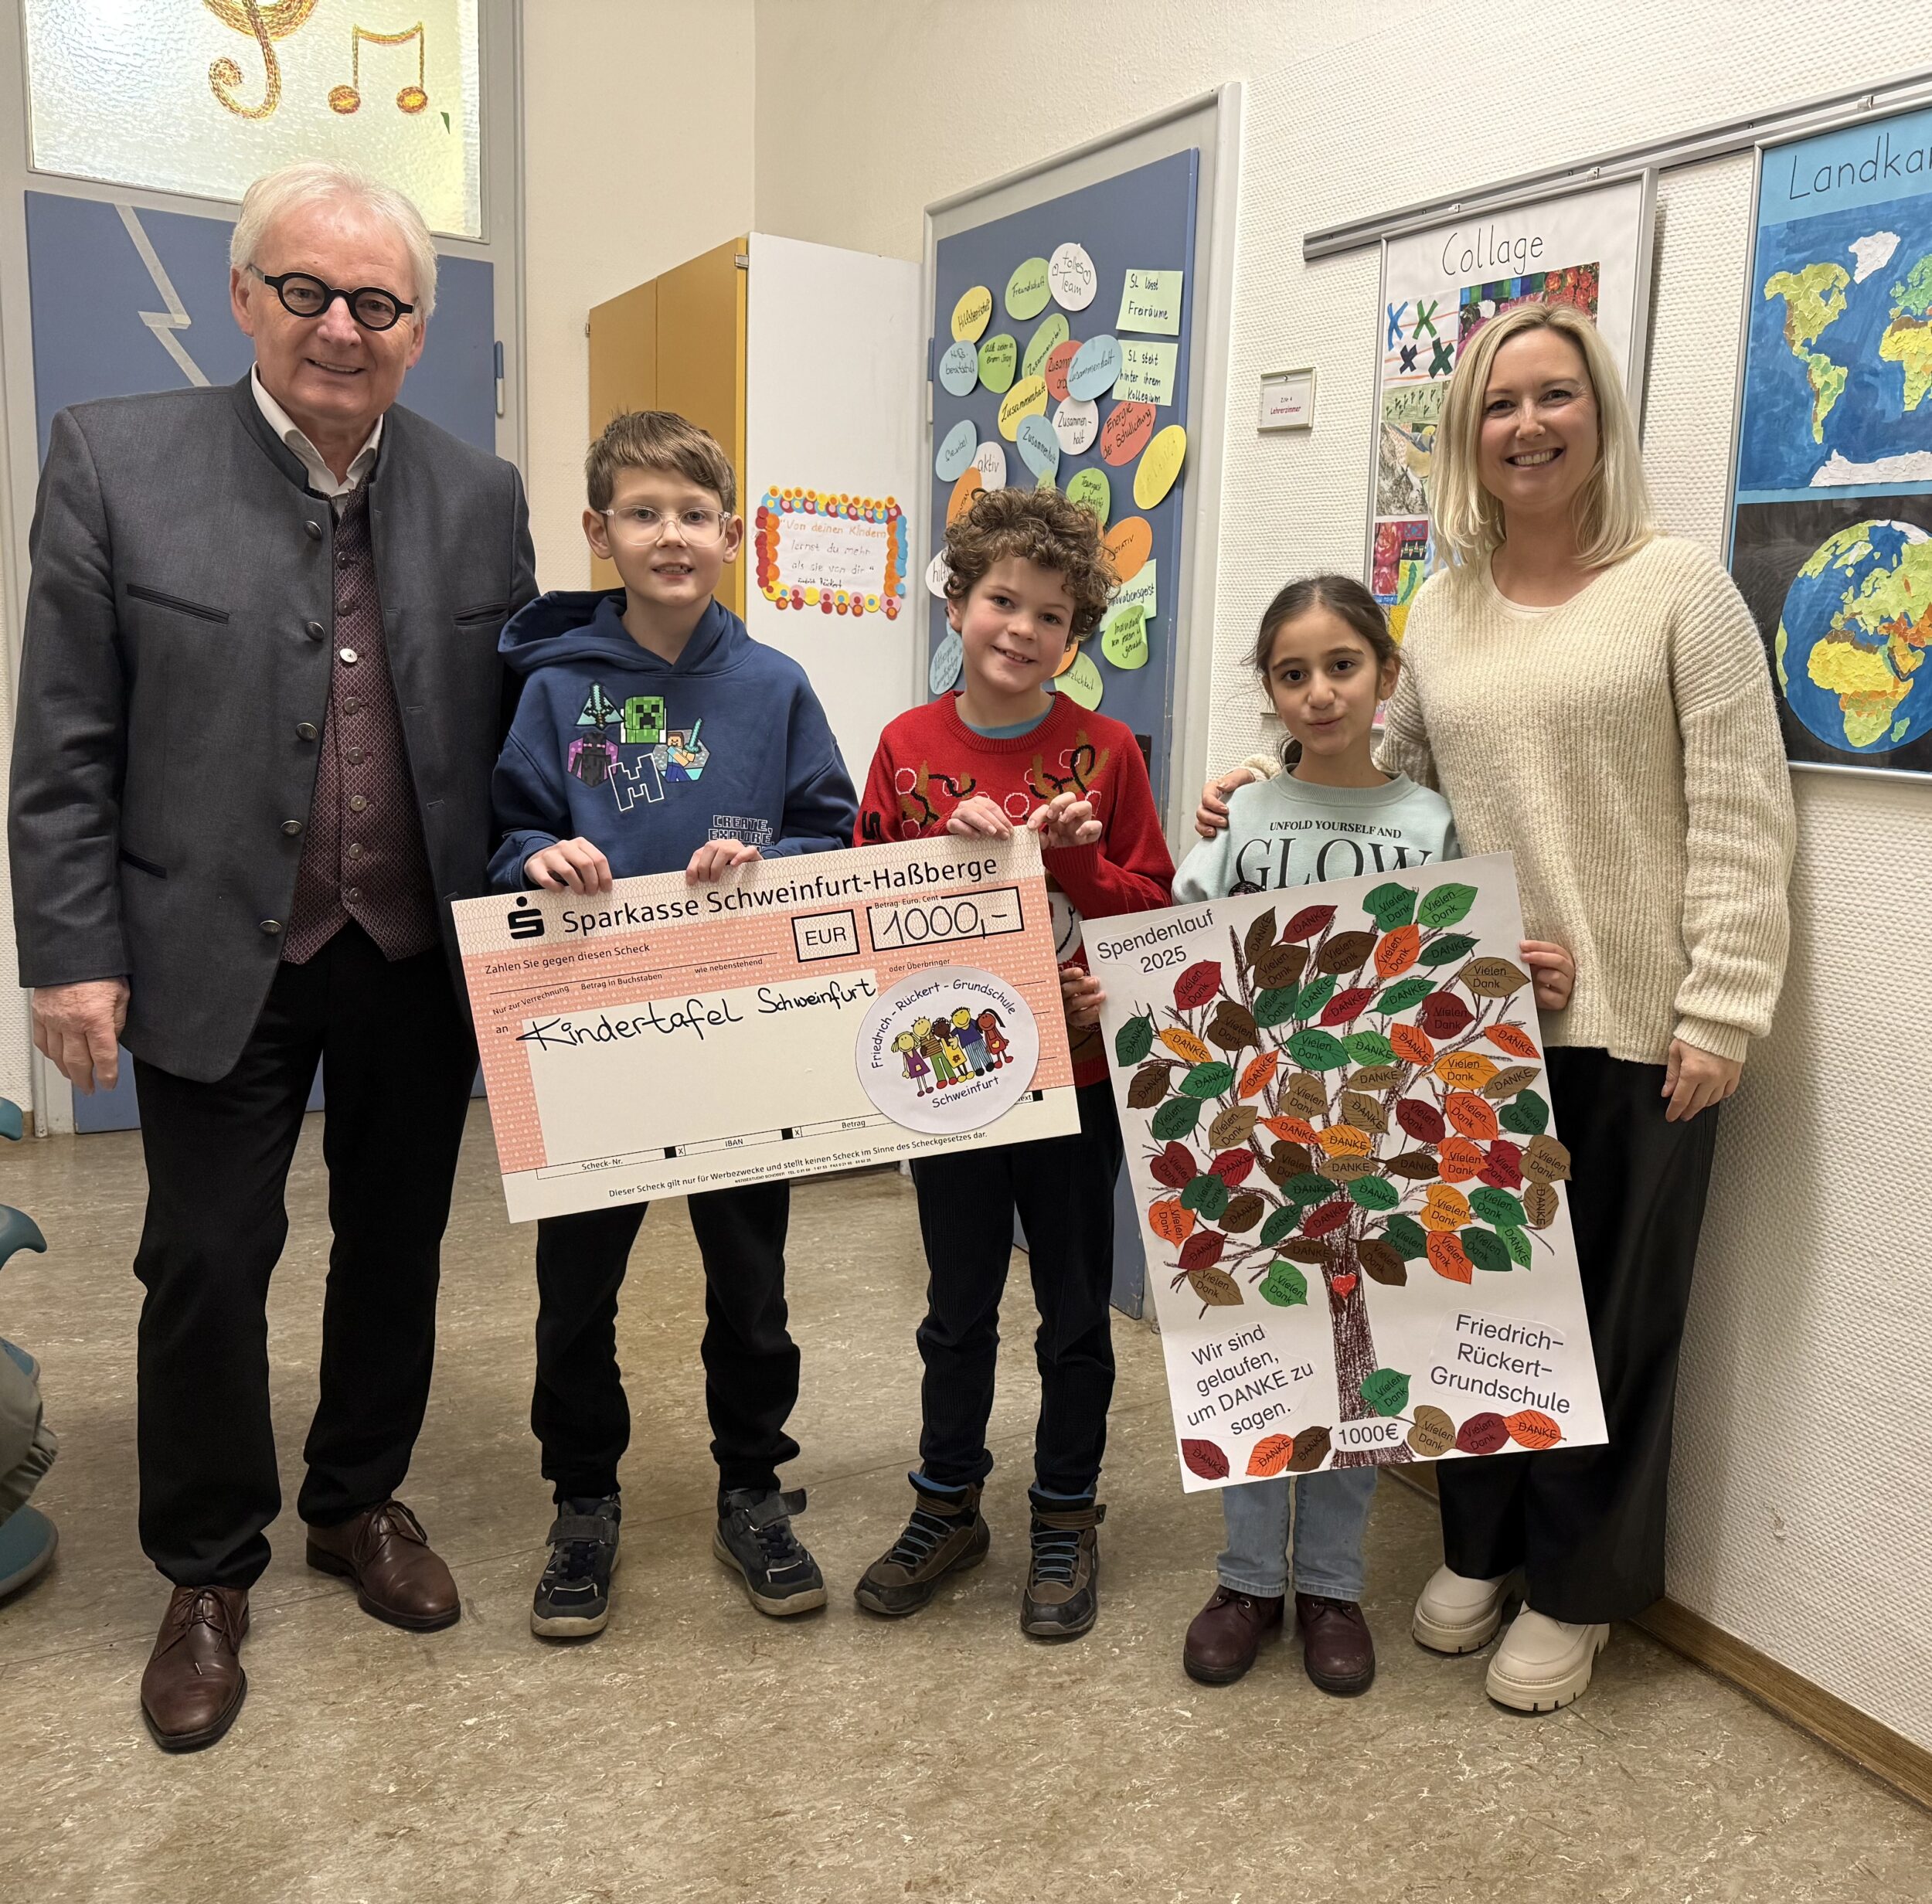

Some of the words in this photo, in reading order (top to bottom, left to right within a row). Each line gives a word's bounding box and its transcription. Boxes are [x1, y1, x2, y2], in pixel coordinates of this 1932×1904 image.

[1789, 132, 1932, 200] Landka
[1442, 225, 1543, 275] Collage
[1059, 271, 1082, 295] Team
[1129, 273, 1139, 289] SL
[1128, 301, 1169, 320] Freiräume
[1128, 349, 1137, 362] SL
[1141, 352, 1158, 366] steht
[1144, 372, 1161, 387] ihrem
[1128, 387, 1161, 404] Kollegium
[1107, 403, 1134, 434] Energie
[978, 454, 999, 473] aktiv
[811, 522, 843, 534] deinen
[827, 542, 838, 553] du
[844, 546, 870, 556] mehr
[792, 560, 804, 570] als
[811, 563, 823, 572] sie
[713, 814, 773, 834] CREATE,
[1270, 820, 1312, 831] UNFOLD
[1315, 820, 1376, 835] YOURSELF
[1377, 828, 1402, 839] AND
[562, 899, 699, 933] Sparkasse
[706, 858, 997, 913] Schweinfurt-Haßberge
[922, 894, 939, 903] Cent
[1379, 889, 1410, 913] Vielen
[1423, 890, 1456, 912] Vielen
[1386, 903, 1412, 923] Dank
[1431, 903, 1458, 923] Dank
[805, 926, 846, 947] EUR
[1097, 909, 1213, 960] Spendenlauf
[485, 960, 521, 974] Zahlen
[523, 958, 539, 970] Sie
[542, 954, 575, 968] gegen
[577, 950, 612, 961] diesen
[614, 943, 651, 956] Scheck
[1140, 945, 1187, 973] 2025
[1379, 936, 1402, 964] Vielen
[1389, 947, 1409, 972] Dank
[581, 979, 607, 991] Betrag
[617, 972, 662, 985] Buchstaben
[694, 966, 709, 974] wie
[709, 958, 764, 973] nebenstehend
[889, 964, 906, 973] oder
[906, 957, 951, 971] Überbringer
[1474, 965, 1507, 976] Vielen
[1178, 969, 1203, 995] Vielen
[1189, 981, 1210, 1004] Dank
[1473, 978, 1500, 988] Dank
[492, 1006, 507, 1016] Nur
[509, 1001, 521, 1011] zur
[520, 984, 570, 1006] Verrechnung
[1331, 991, 1366, 1017] DANKE
[515, 998, 743, 1051] Kindertafel
[757, 978, 876, 1014] Schweinfurt
[871, 1015, 892, 1069] Friedrich
[895, 981, 940, 1011] Rückert
[953, 979, 1015, 1015] Grundschule
[495, 1025, 509, 1034] an
[1172, 1034, 1208, 1059] DANKE
[1302, 1035, 1332, 1051] Vielen
[1498, 1030, 1535, 1055] DANKE
[1298, 1048, 1324, 1062] Dank
[1447, 1059, 1480, 1069] Vielen
[1246, 1054, 1274, 1086] DANKE
[1360, 1070, 1398, 1083] DANKE
[1447, 1071, 1475, 1081] Dank
[1495, 1069, 1532, 1090] DANKE
[932, 1076, 998, 1108] Schweinfurt
[1451, 1107, 1474, 1128] Dank
[1461, 1098, 1488, 1123] Vielen
[725, 1138, 743, 1148] IBAN
[842, 1119, 866, 1130] Betrag
[1280, 1122, 1318, 1142] DANKE
[609, 1186, 635, 1198] Dieser
[637, 1182, 665, 1194] Scheck
[667, 1179, 681, 1191] gilt
[682, 1178, 696, 1186] nur
[698, 1174, 709, 1183] für
[710, 1165, 764, 1182] Werbezwecke
[767, 1163, 782, 1172] und
[784, 1160, 804, 1169] stellt
[804, 1156, 832, 1165] keinen
[832, 1151, 859, 1161] Scheck
[872, 1144, 895, 1154] Sinne
[897, 1141, 910, 1151] des
[912, 1134, 971, 1150] Scheckgesetzes
[974, 1130, 988, 1139] dar.
[1332, 1163, 1370, 1172] DANKE
[1450, 1152, 1481, 1164] Vielen
[1537, 1150, 1566, 1172] Vielen
[1448, 1164, 1475, 1175] Dank
[1530, 1161, 1556, 1180] Dank
[1437, 1198, 1467, 1219] Vielen
[1477, 1202, 1502, 1219] Dank
[1483, 1192, 1512, 1211] Vielen
[1536, 1188, 1546, 1226] DANKE
[1431, 1210, 1458, 1227] Dank
[1505, 1228, 1530, 1263] DANKE
[1196, 1281, 1219, 1298] Dank
[1201, 1270, 1230, 1290] Vielen
[1277, 1275, 1304, 1298] Vielen
[1270, 1285, 1294, 1304] Dank
[1455, 1314, 1563, 1350] Friedrich-
[1191, 1341, 1223, 1365] Wir
[1227, 1324, 1265, 1352] sind
[1458, 1342, 1553, 1377] Rückert-
[1196, 1352, 1279, 1396] gelaufen,
[1187, 1404, 1216, 1426] um
[1218, 1370, 1288, 1412] DANKE
[1291, 1362, 1314, 1382] zu
[1376, 1373, 1403, 1398] Vielen
[1430, 1366, 1570, 1413] Grundschule
[1383, 1388, 1408, 1408] Dank
[1230, 1402, 1291, 1435] sagen.
[1338, 1423, 1399, 1446] 1000€
[1423, 1420, 1454, 1442] Vielen
[1519, 1422, 1557, 1439] DANKE
[1419, 1433, 1444, 1451] Dank
